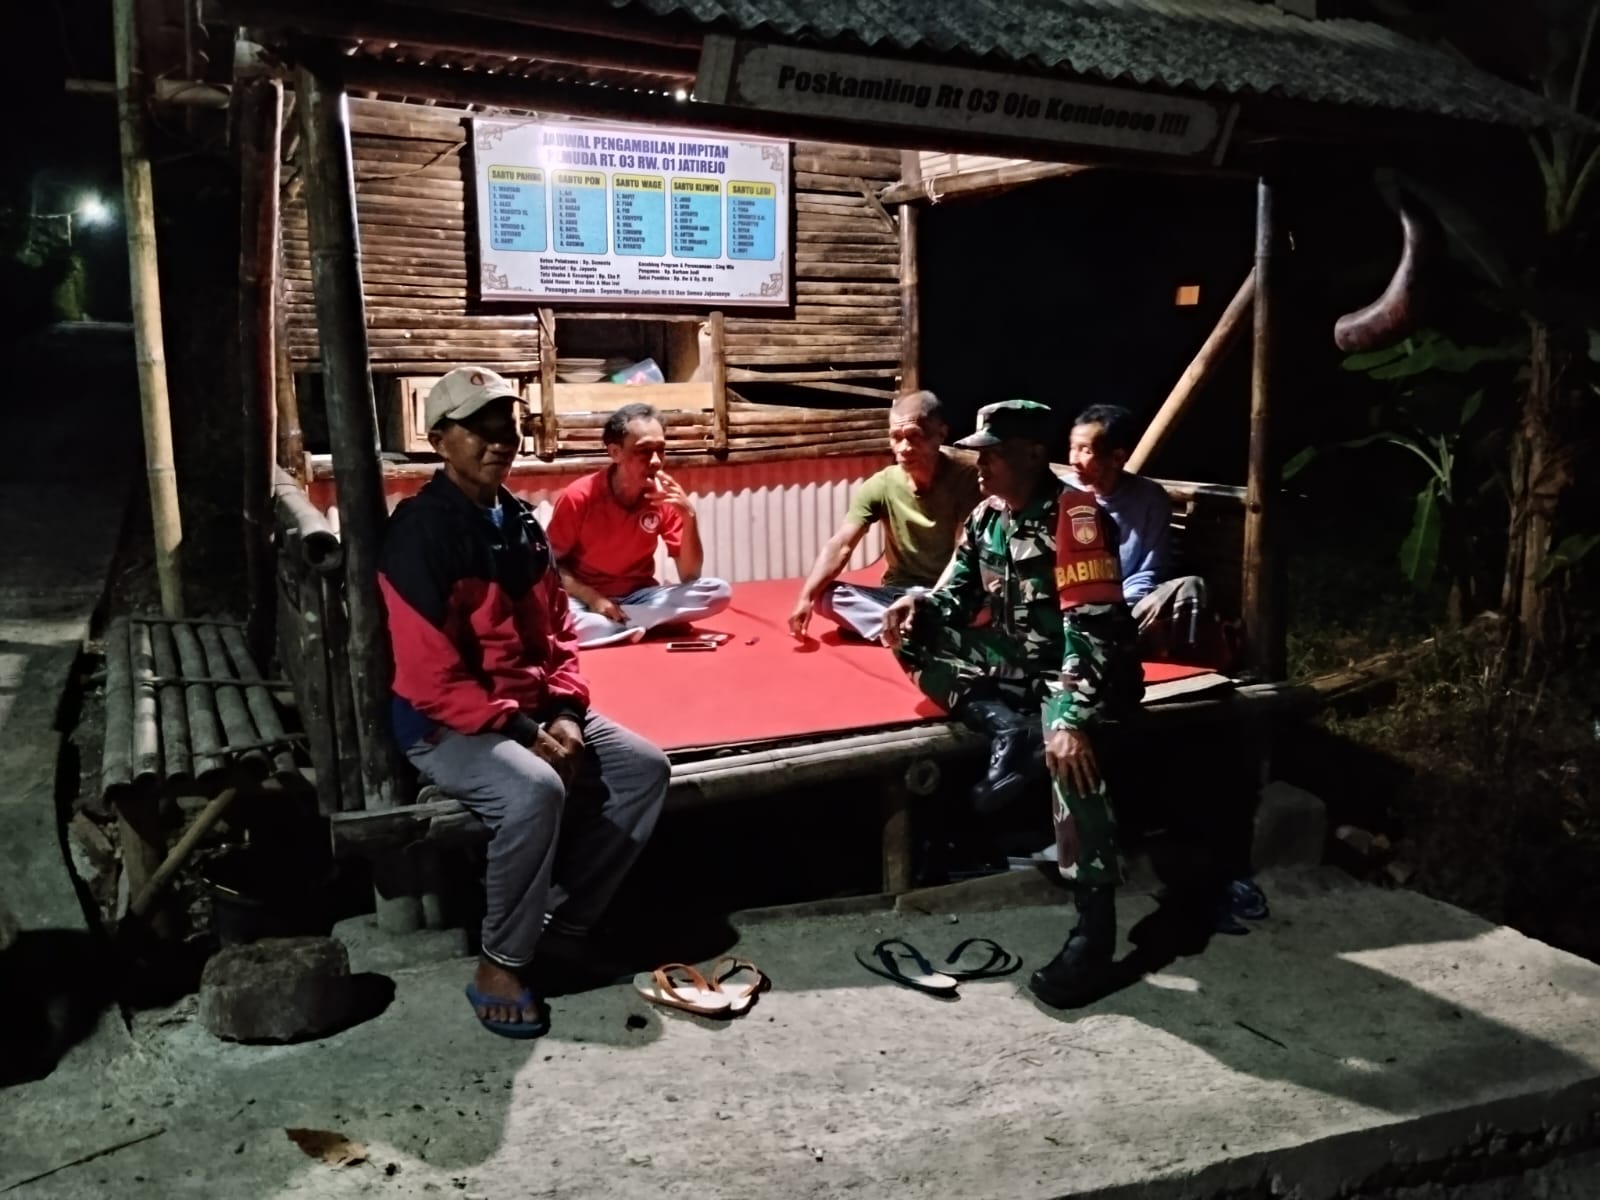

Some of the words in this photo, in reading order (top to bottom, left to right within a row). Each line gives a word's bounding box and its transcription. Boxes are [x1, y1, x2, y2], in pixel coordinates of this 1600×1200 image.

[777, 65, 932, 109] Poskamling
[935, 84, 963, 110] Rt
[967, 87, 999, 114] 03
[1003, 92, 1041, 119] Ojo
[593, 136, 675, 156] PENGAMBILAN
[677, 142, 729, 159] JIMPITAN
[547, 149, 598, 166] PMUDA
[600, 153, 617, 168] RT.
[619, 154, 635, 169] 03
[637, 156, 660, 170] RW.
[662, 157, 675, 171] 01
[676, 158, 726, 174] JATIREJO
[492, 170, 514, 180] SABTU
[558, 174, 583, 185] SABTU
[584, 176, 601, 186] PON
[616, 178, 640, 188] SABTU
[641, 180, 662, 190] WAGE
[674, 182, 694, 192] SABTU
[732, 185, 754, 195] SABTU
[1054, 558, 1117, 589] BABINS
